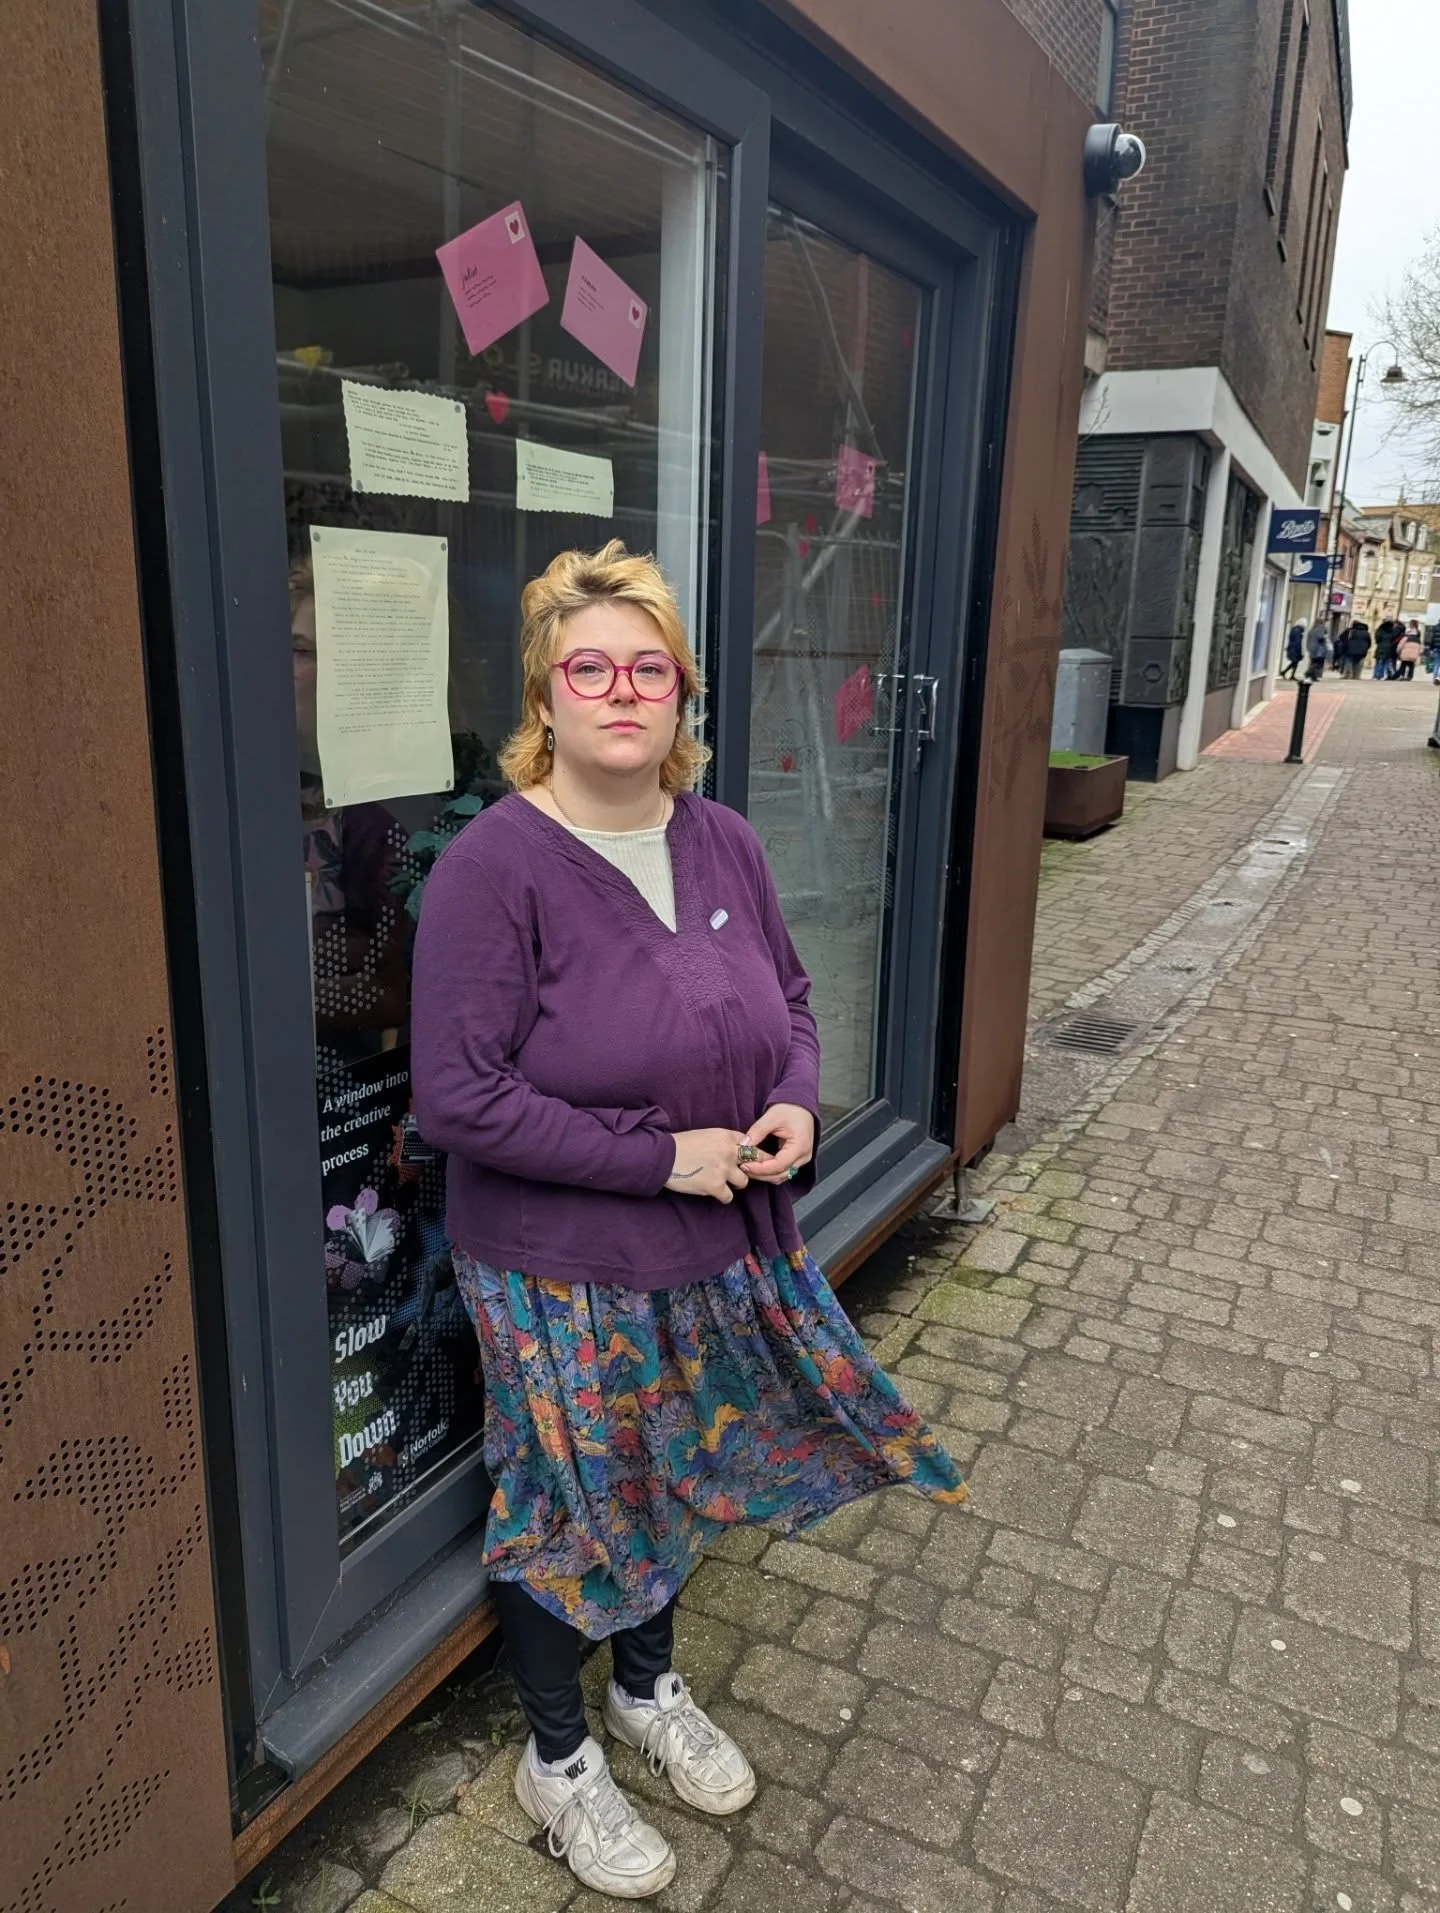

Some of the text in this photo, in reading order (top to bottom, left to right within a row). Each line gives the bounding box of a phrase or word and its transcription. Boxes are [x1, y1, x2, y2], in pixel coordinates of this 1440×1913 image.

[1276, 520, 1315, 539] Boots
[322, 1070, 409, 1114] A window into
[320, 1105, 391, 1142] the creative
[321, 1143, 370, 1177] process
[335, 1315, 386, 1363] Slow
[334, 1371, 373, 1412] You
[338, 1410, 397, 1469] Down
[410, 1417, 447, 1452] Norfolk
[564, 1754, 588, 1780] NIKE
